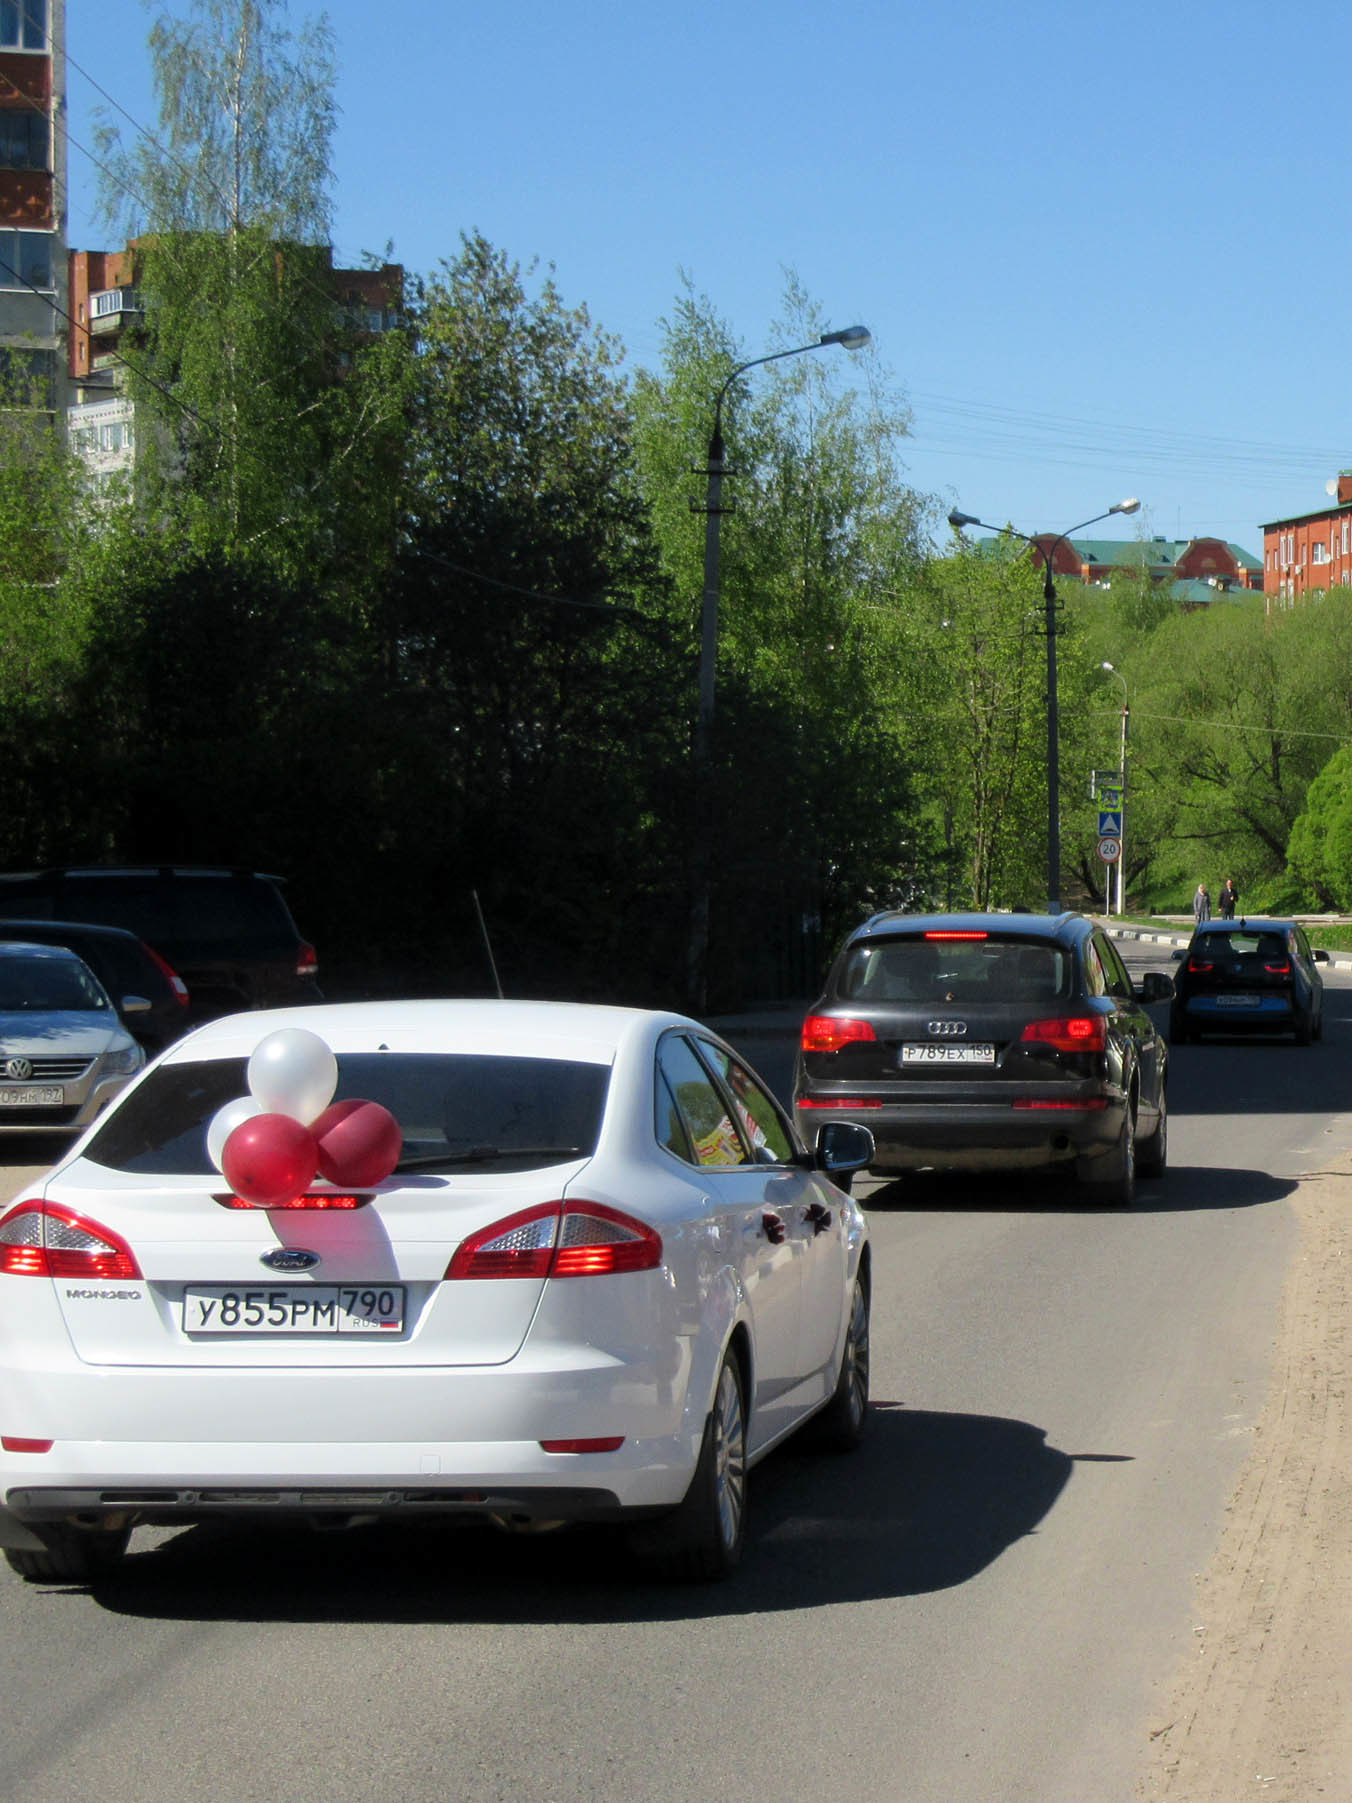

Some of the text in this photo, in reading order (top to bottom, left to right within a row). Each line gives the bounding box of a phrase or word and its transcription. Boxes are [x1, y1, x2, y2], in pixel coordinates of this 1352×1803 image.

[1103, 844, 1116, 855] 20
[908, 1044, 991, 1060] Р789ЕХ 150
[66, 1289, 142, 1300] MONDEO
[199, 1290, 395, 1327] У855РМ 790
[353, 1318, 379, 1328] RUS
